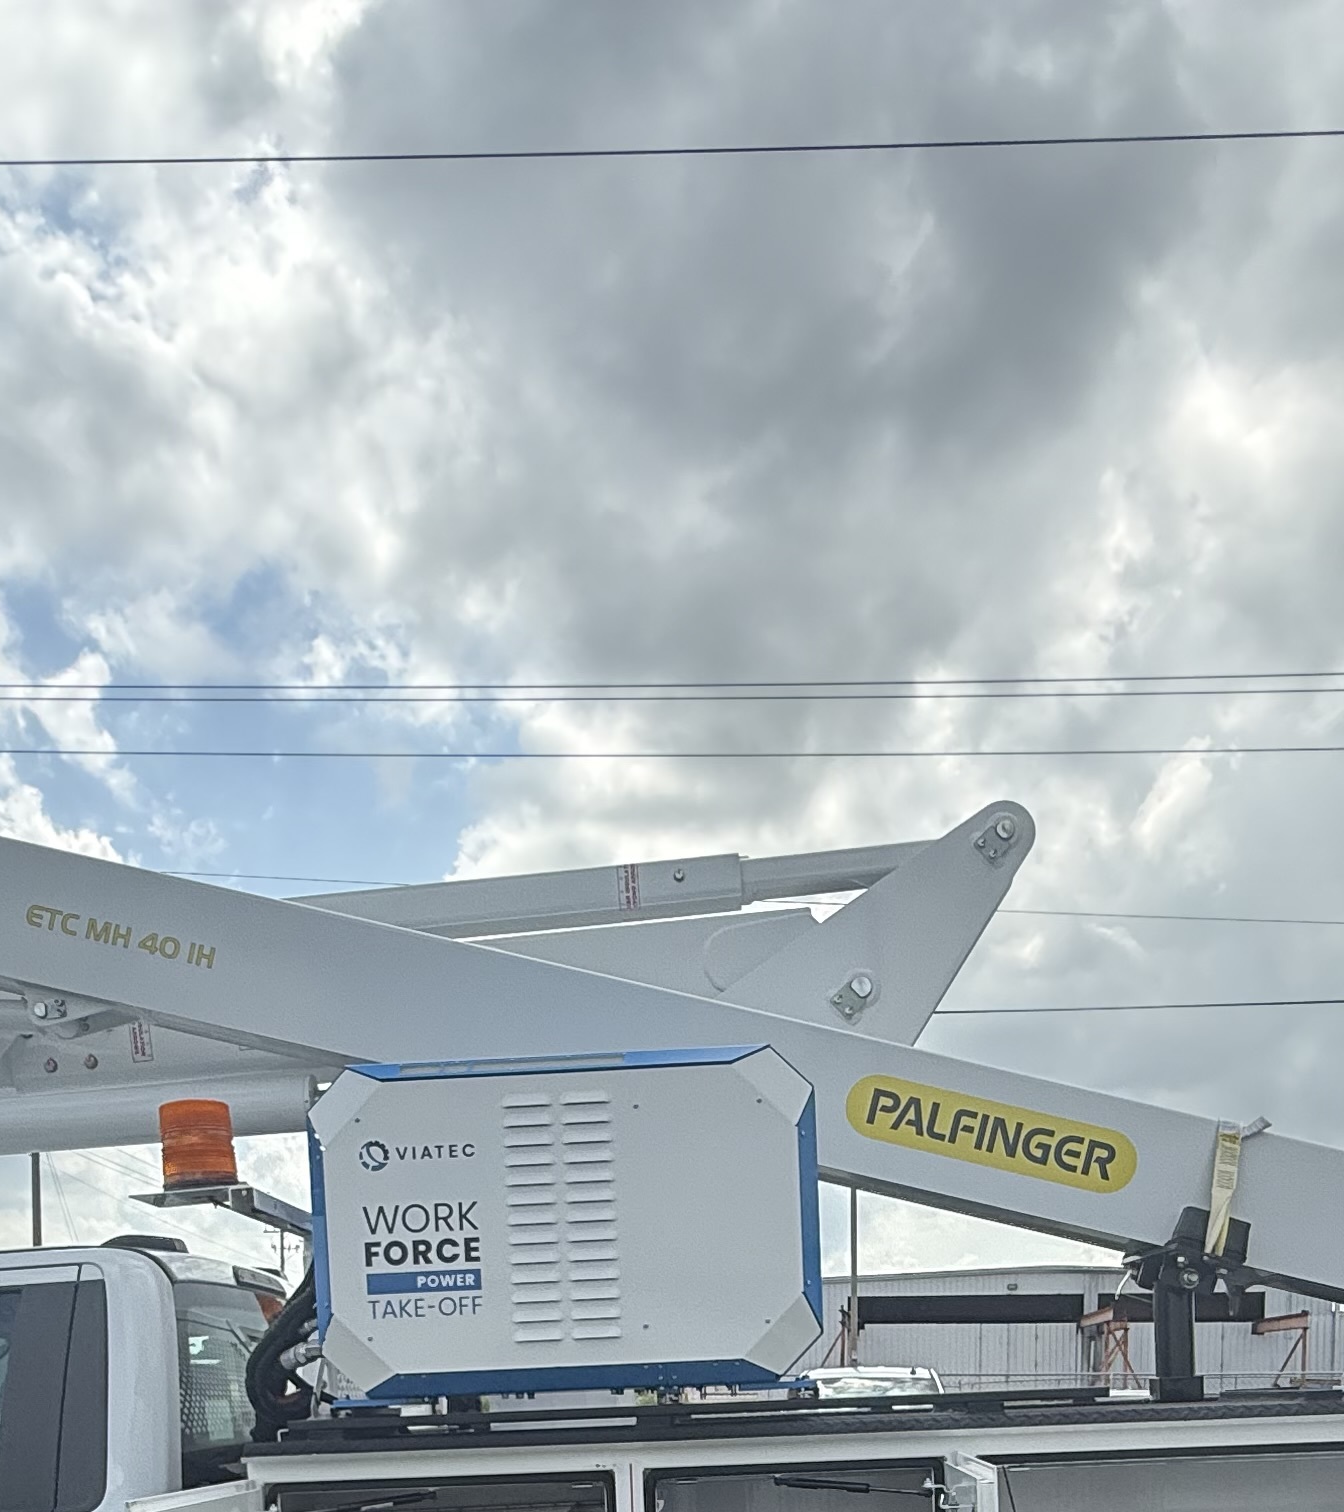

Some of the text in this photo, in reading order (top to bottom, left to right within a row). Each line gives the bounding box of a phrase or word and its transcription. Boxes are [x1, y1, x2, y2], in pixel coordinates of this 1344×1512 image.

[26, 904, 216, 969] ETC MH 40 IH
[866, 1087, 1116, 1181] PALFINGER
[395, 1143, 476, 1161] VIATEC
[362, 1200, 479, 1235] WORK
[364, 1236, 481, 1267] FORCE
[416, 1273, 475, 1288] POWER
[367, 1295, 483, 1320] TAKE-OFF
